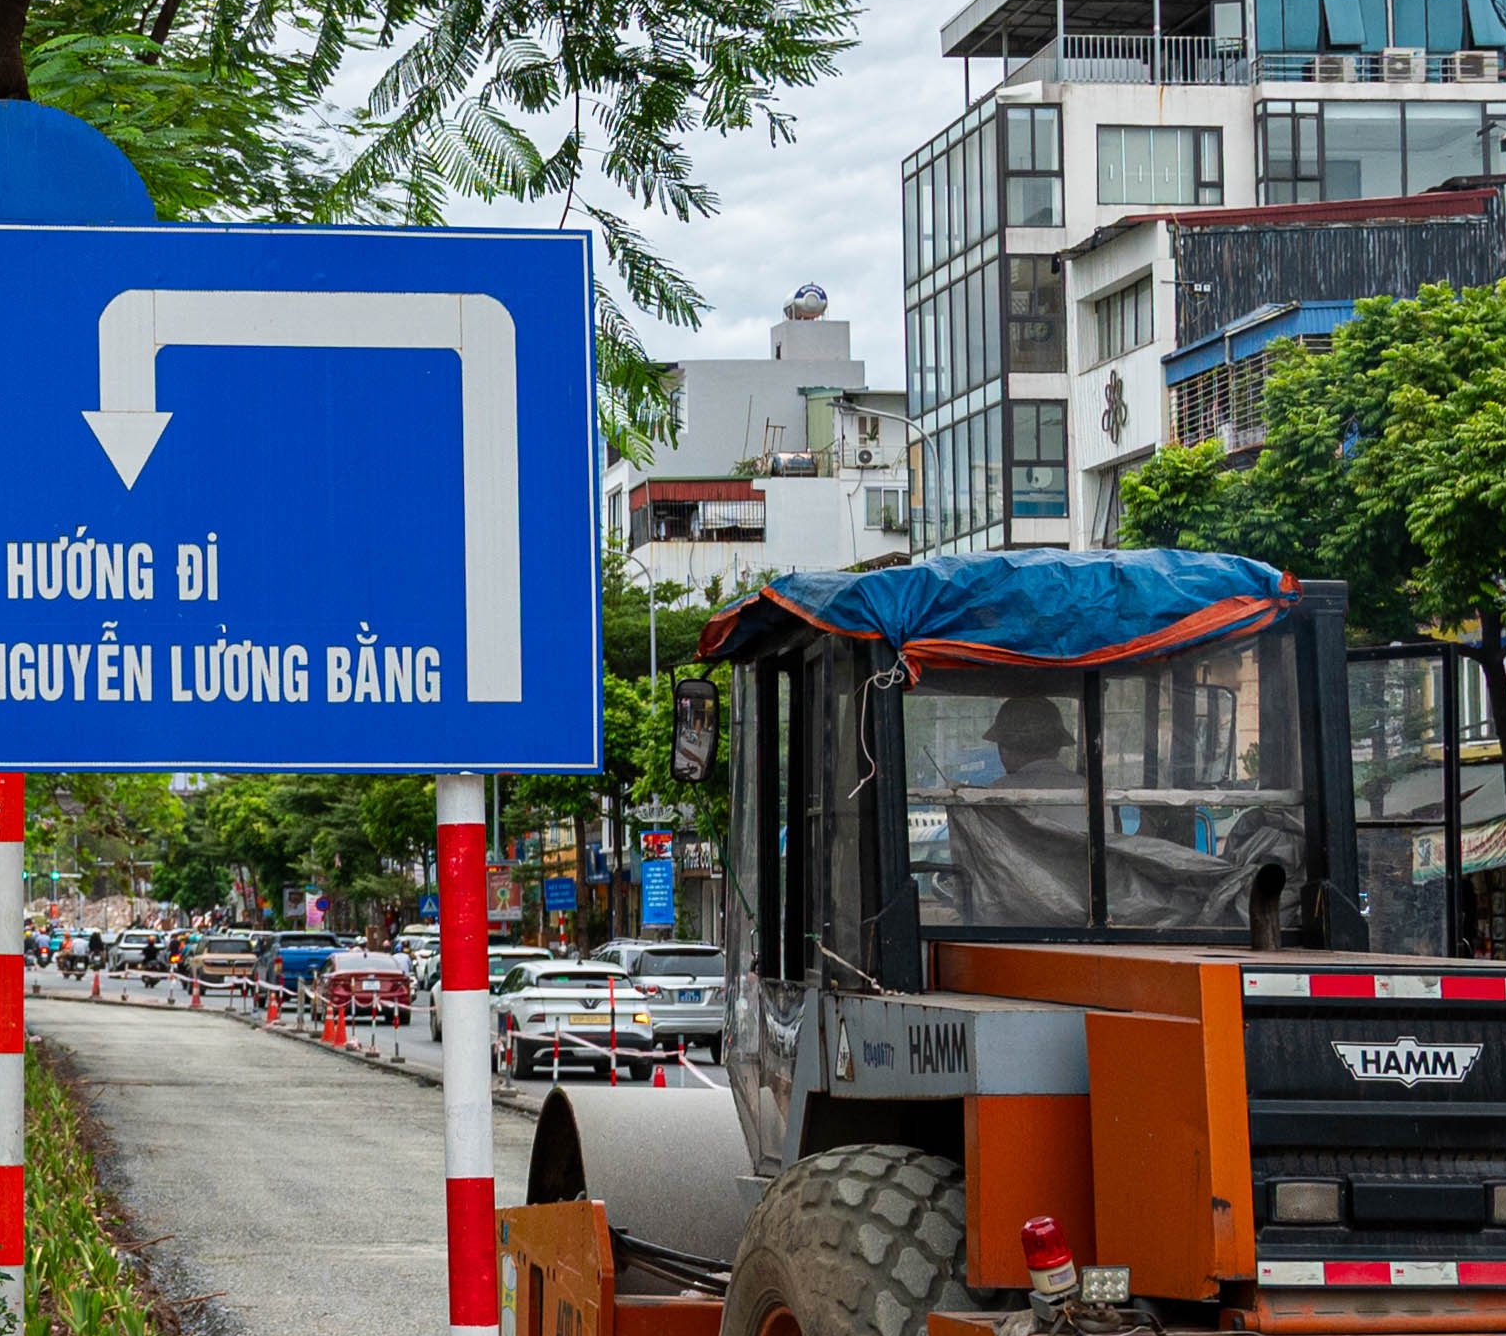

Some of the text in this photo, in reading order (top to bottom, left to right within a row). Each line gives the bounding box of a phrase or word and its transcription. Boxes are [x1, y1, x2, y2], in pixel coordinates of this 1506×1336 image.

[8, 526, 153, 600] HƯỚNG
[171, 638, 308, 702] LƯƠNG
[327, 622, 441, 702] BẰNG
[908, 1022, 969, 1075] HAMM
[1360, 1049, 1458, 1076] HAMM
